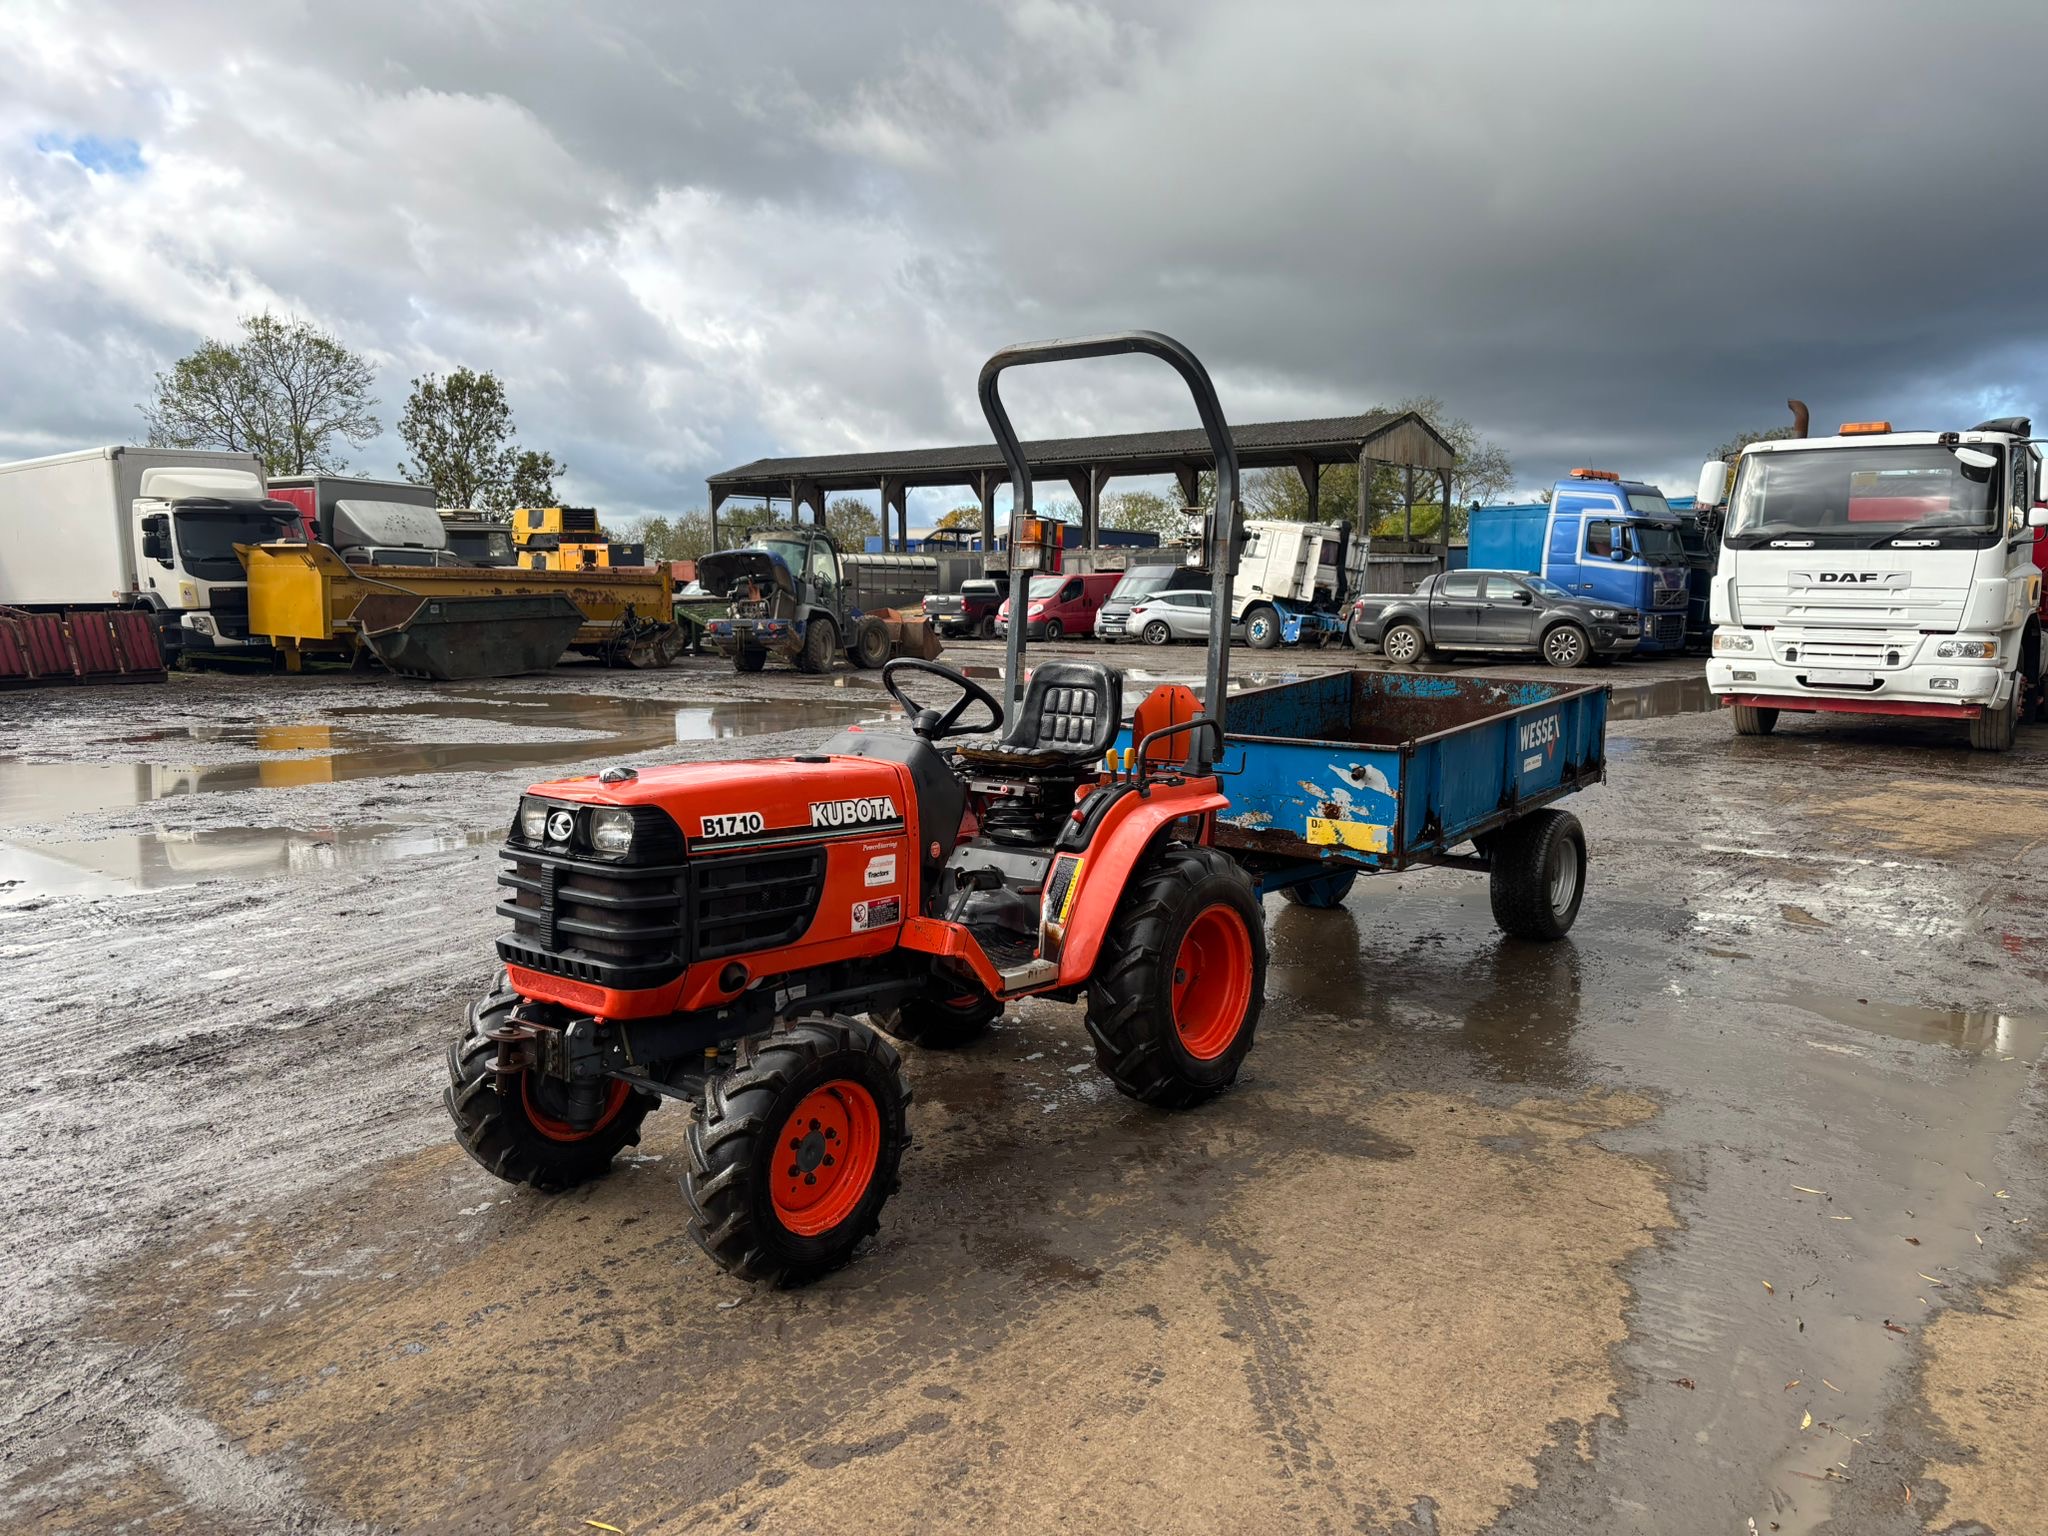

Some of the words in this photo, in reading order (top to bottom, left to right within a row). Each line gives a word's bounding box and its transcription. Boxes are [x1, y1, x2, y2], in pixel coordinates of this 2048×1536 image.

[1820, 573, 1878, 583] DAF
[811, 798, 897, 828] KUBOTA
[702, 814, 761, 836] B1710
[868, 870, 889, 879] Tractors
